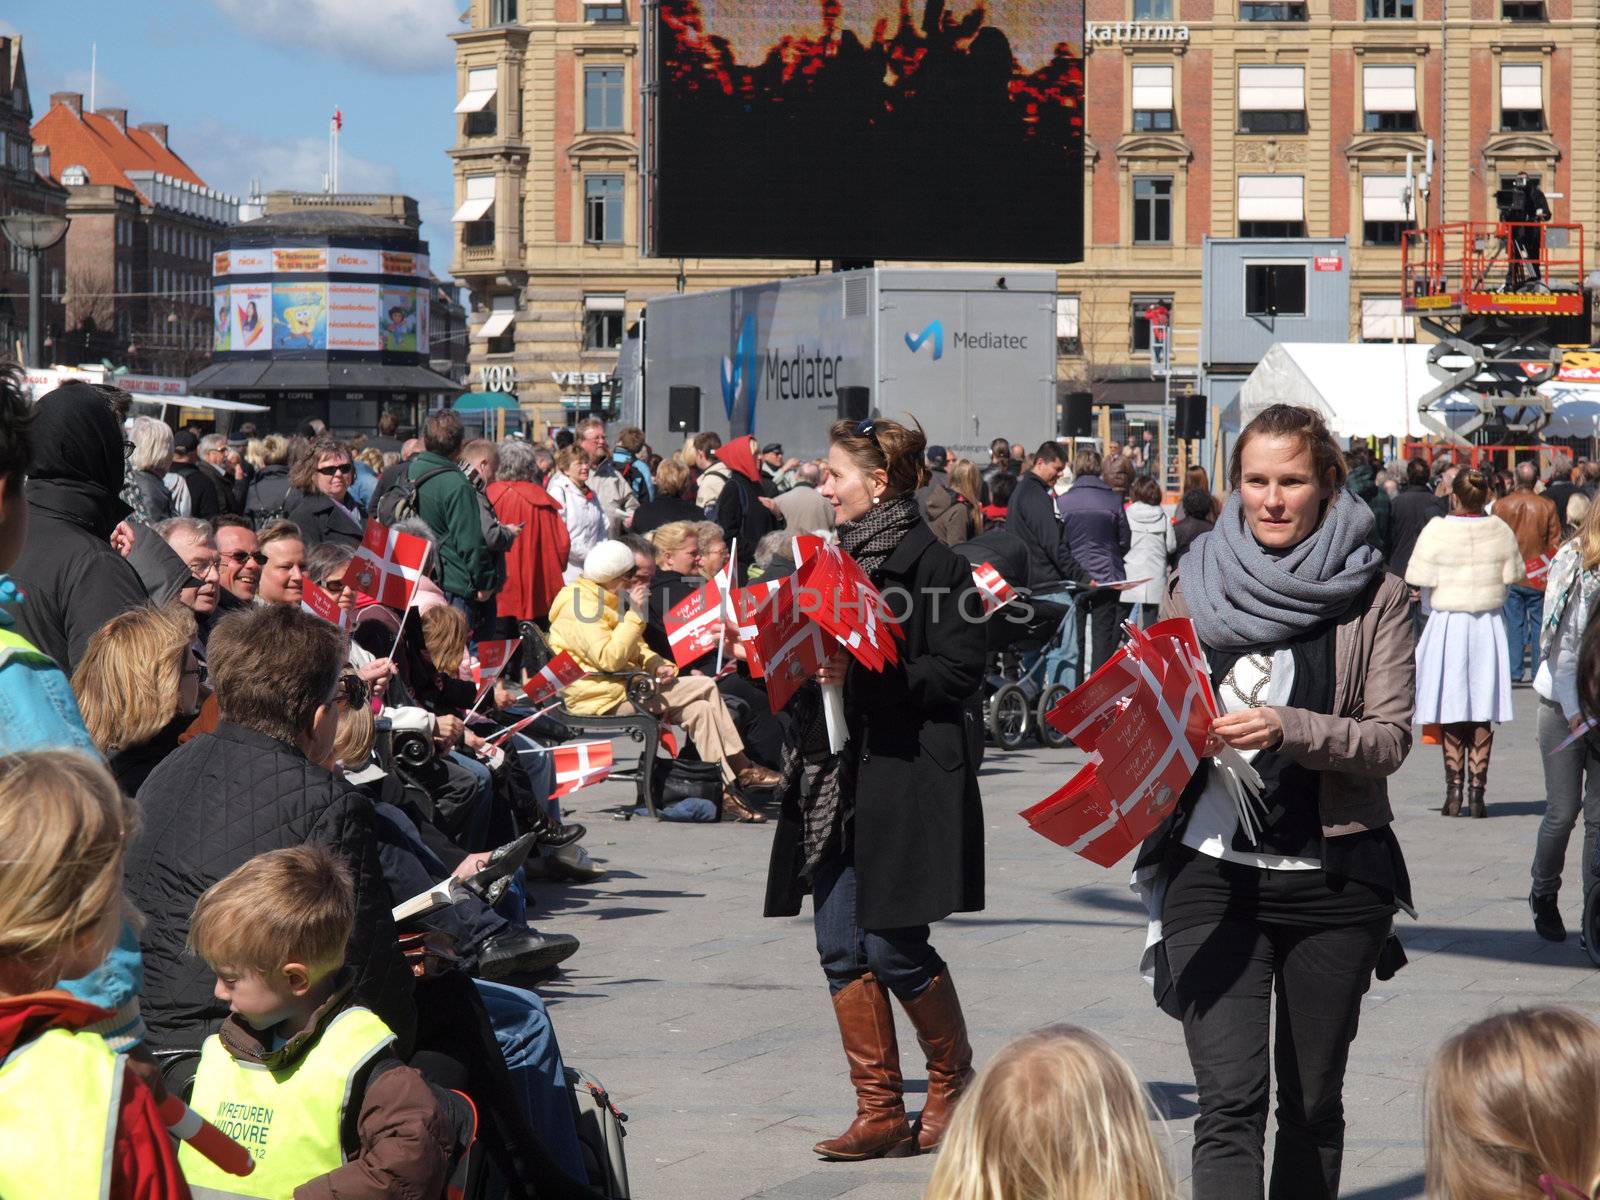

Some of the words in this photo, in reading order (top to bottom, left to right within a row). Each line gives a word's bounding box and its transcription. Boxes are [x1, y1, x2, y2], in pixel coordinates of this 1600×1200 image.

[953, 332, 1028, 349] Mediatec
[766, 347, 843, 400] Mediatec
[287, 392, 313, 400] COFFEE
[346, 392, 364, 400] BEER
